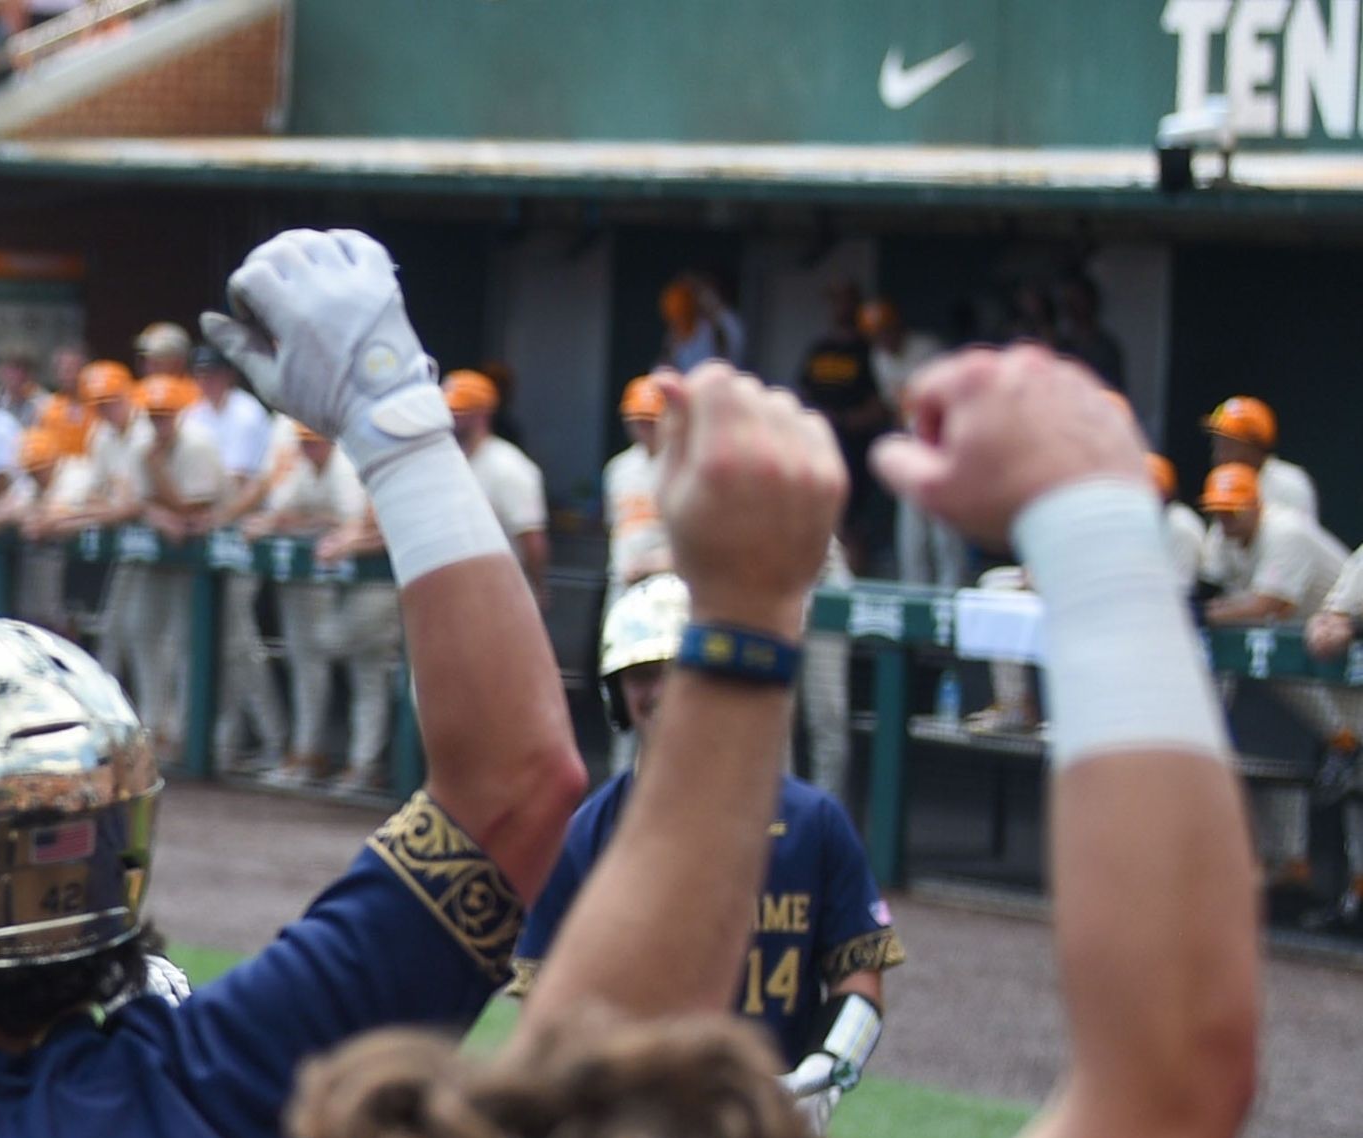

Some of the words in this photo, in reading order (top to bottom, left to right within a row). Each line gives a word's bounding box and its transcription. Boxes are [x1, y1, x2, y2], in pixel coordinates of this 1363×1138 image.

[1159, 0, 1363, 140] TEN
[751, 893, 811, 934] ME
[744, 946, 801, 1016] 14
